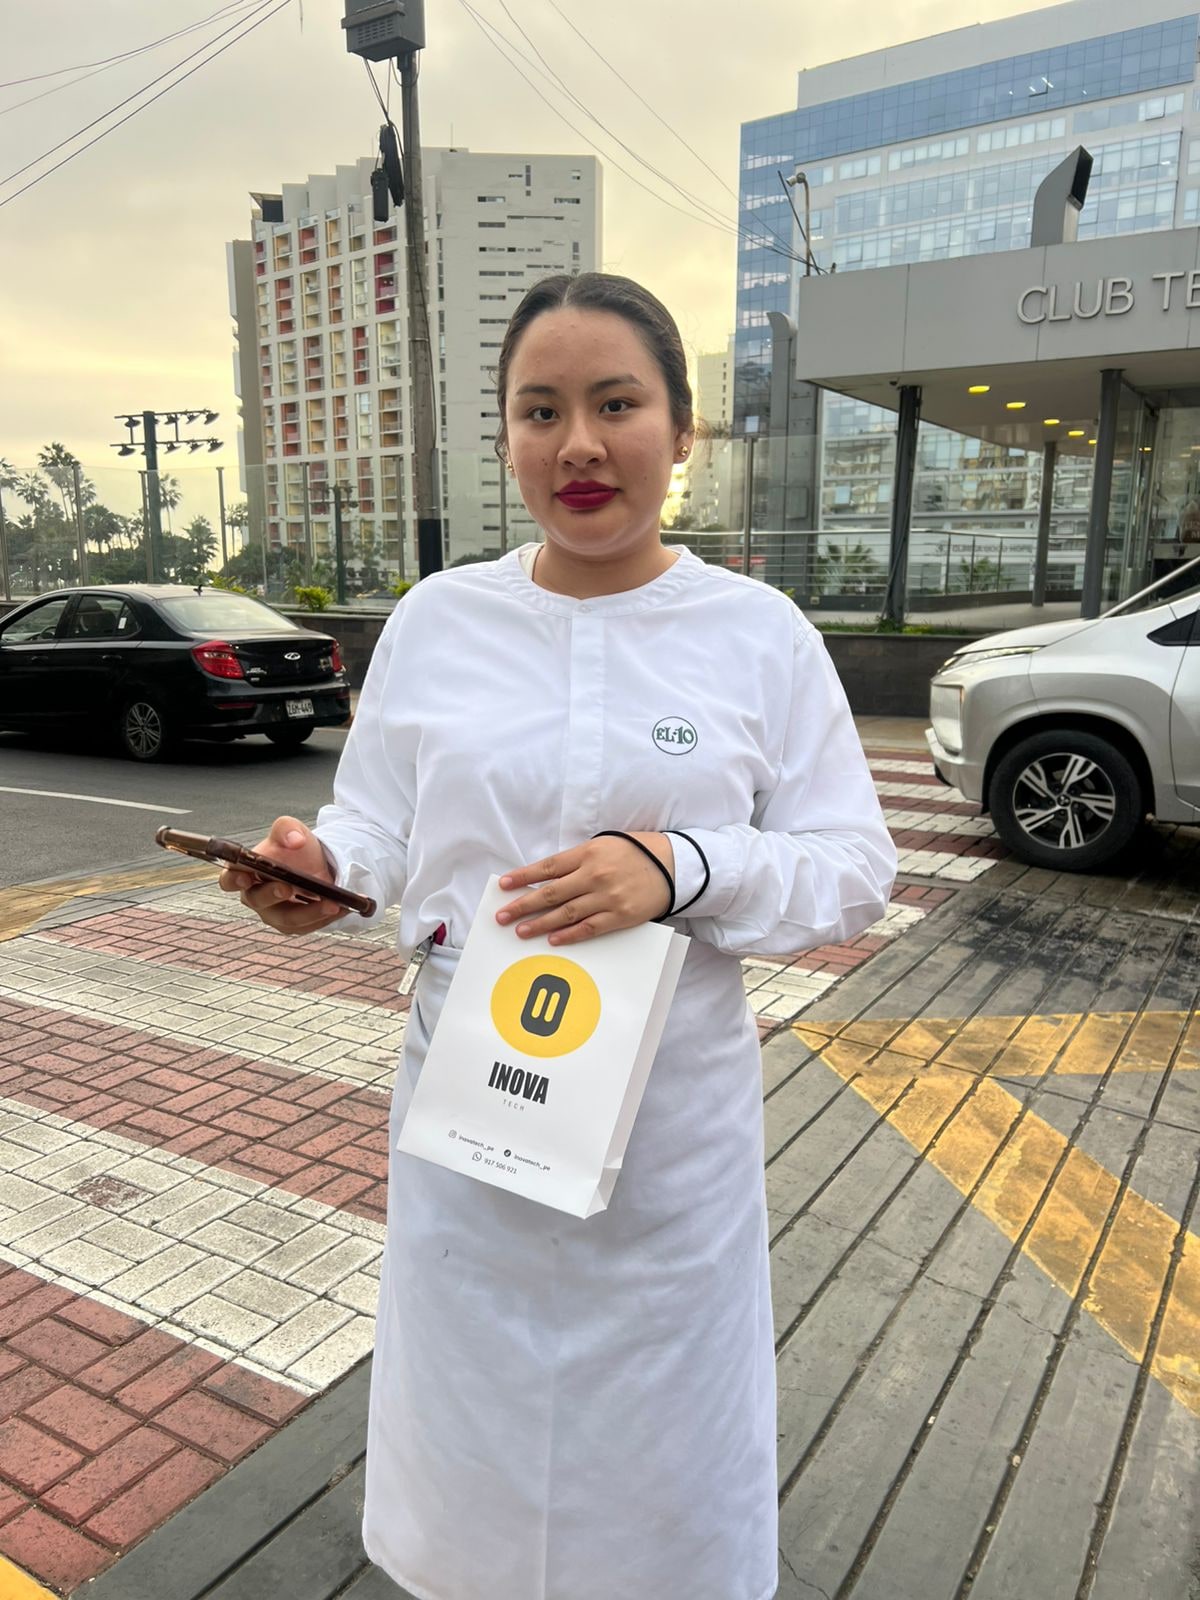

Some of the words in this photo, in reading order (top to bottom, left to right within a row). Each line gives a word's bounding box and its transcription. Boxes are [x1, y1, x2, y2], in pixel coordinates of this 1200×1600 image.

[1017, 277, 1134, 324] CLUB
[488, 1061, 549, 1104] INOVA
[503, 1099, 525, 1111] TECH
